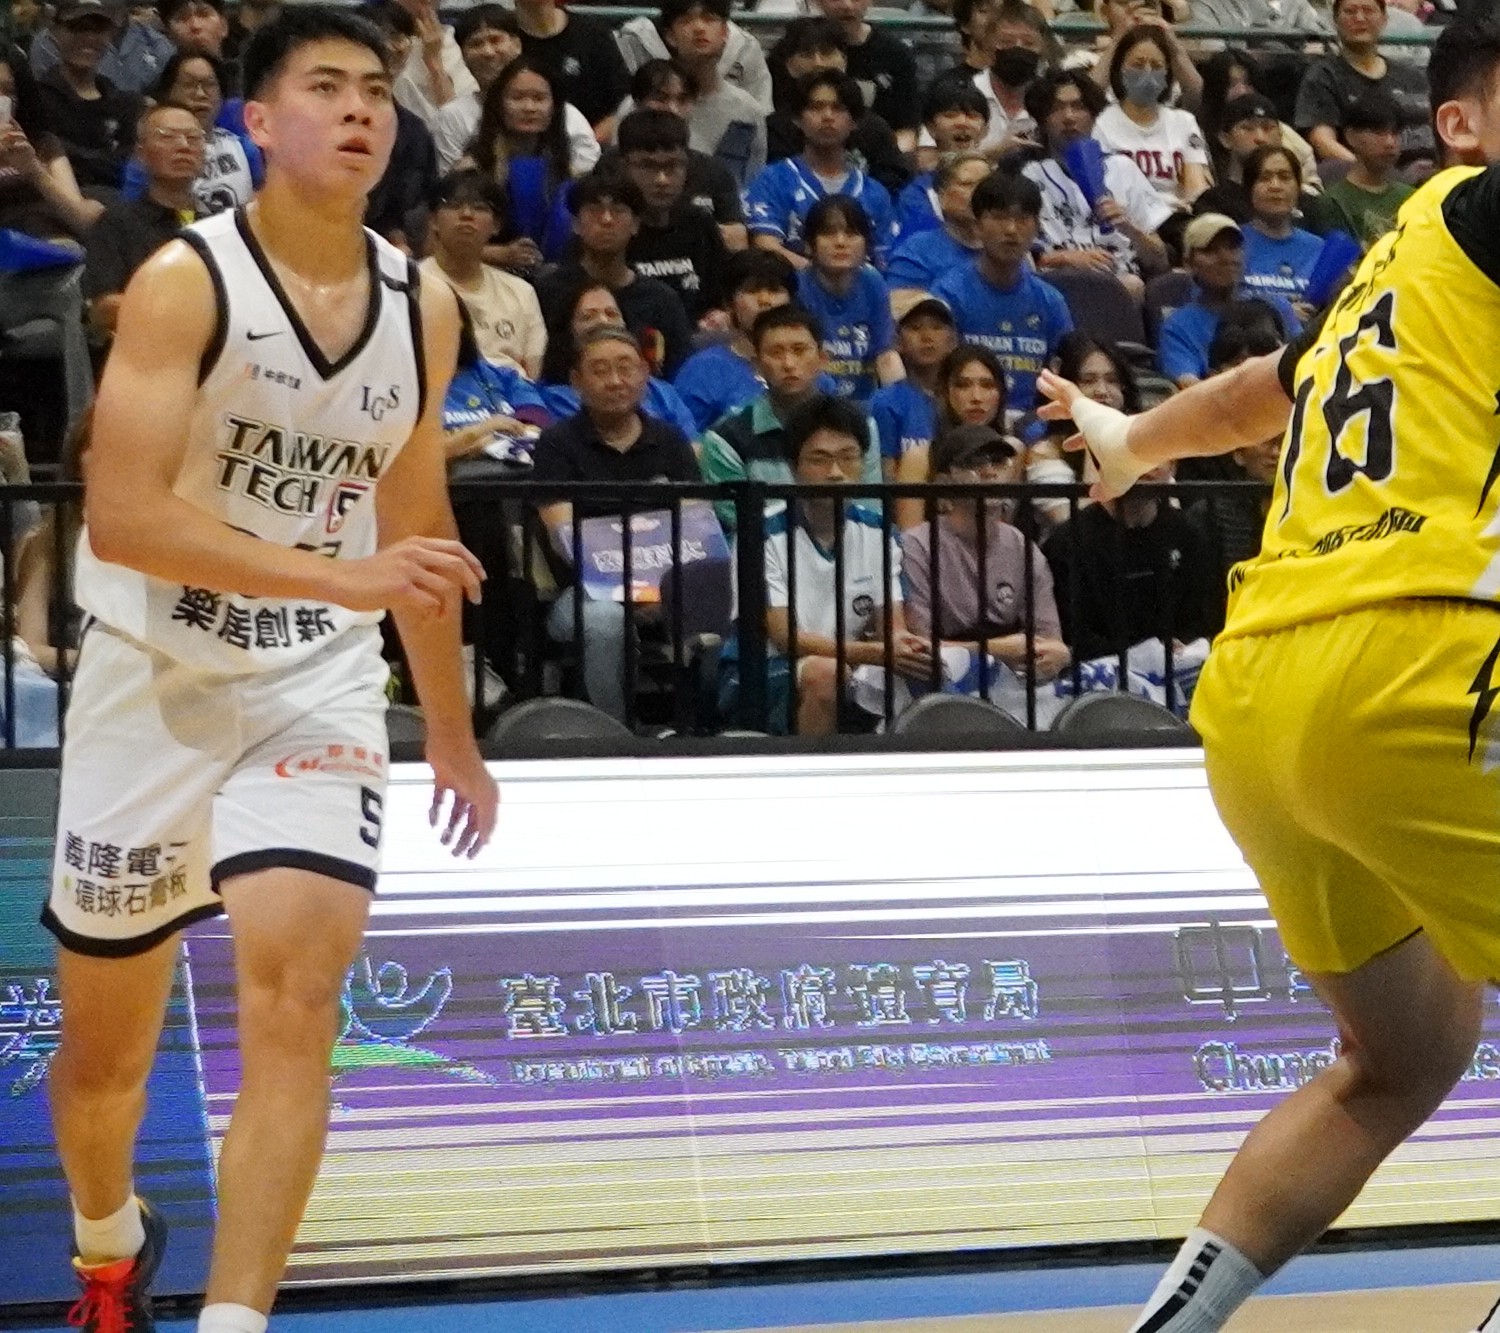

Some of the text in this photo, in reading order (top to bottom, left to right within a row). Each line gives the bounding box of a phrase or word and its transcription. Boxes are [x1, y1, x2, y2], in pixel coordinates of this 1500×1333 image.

[360, 384, 401, 422] IGS
[214, 454, 317, 518] TECH
[359, 784, 383, 851] 5
